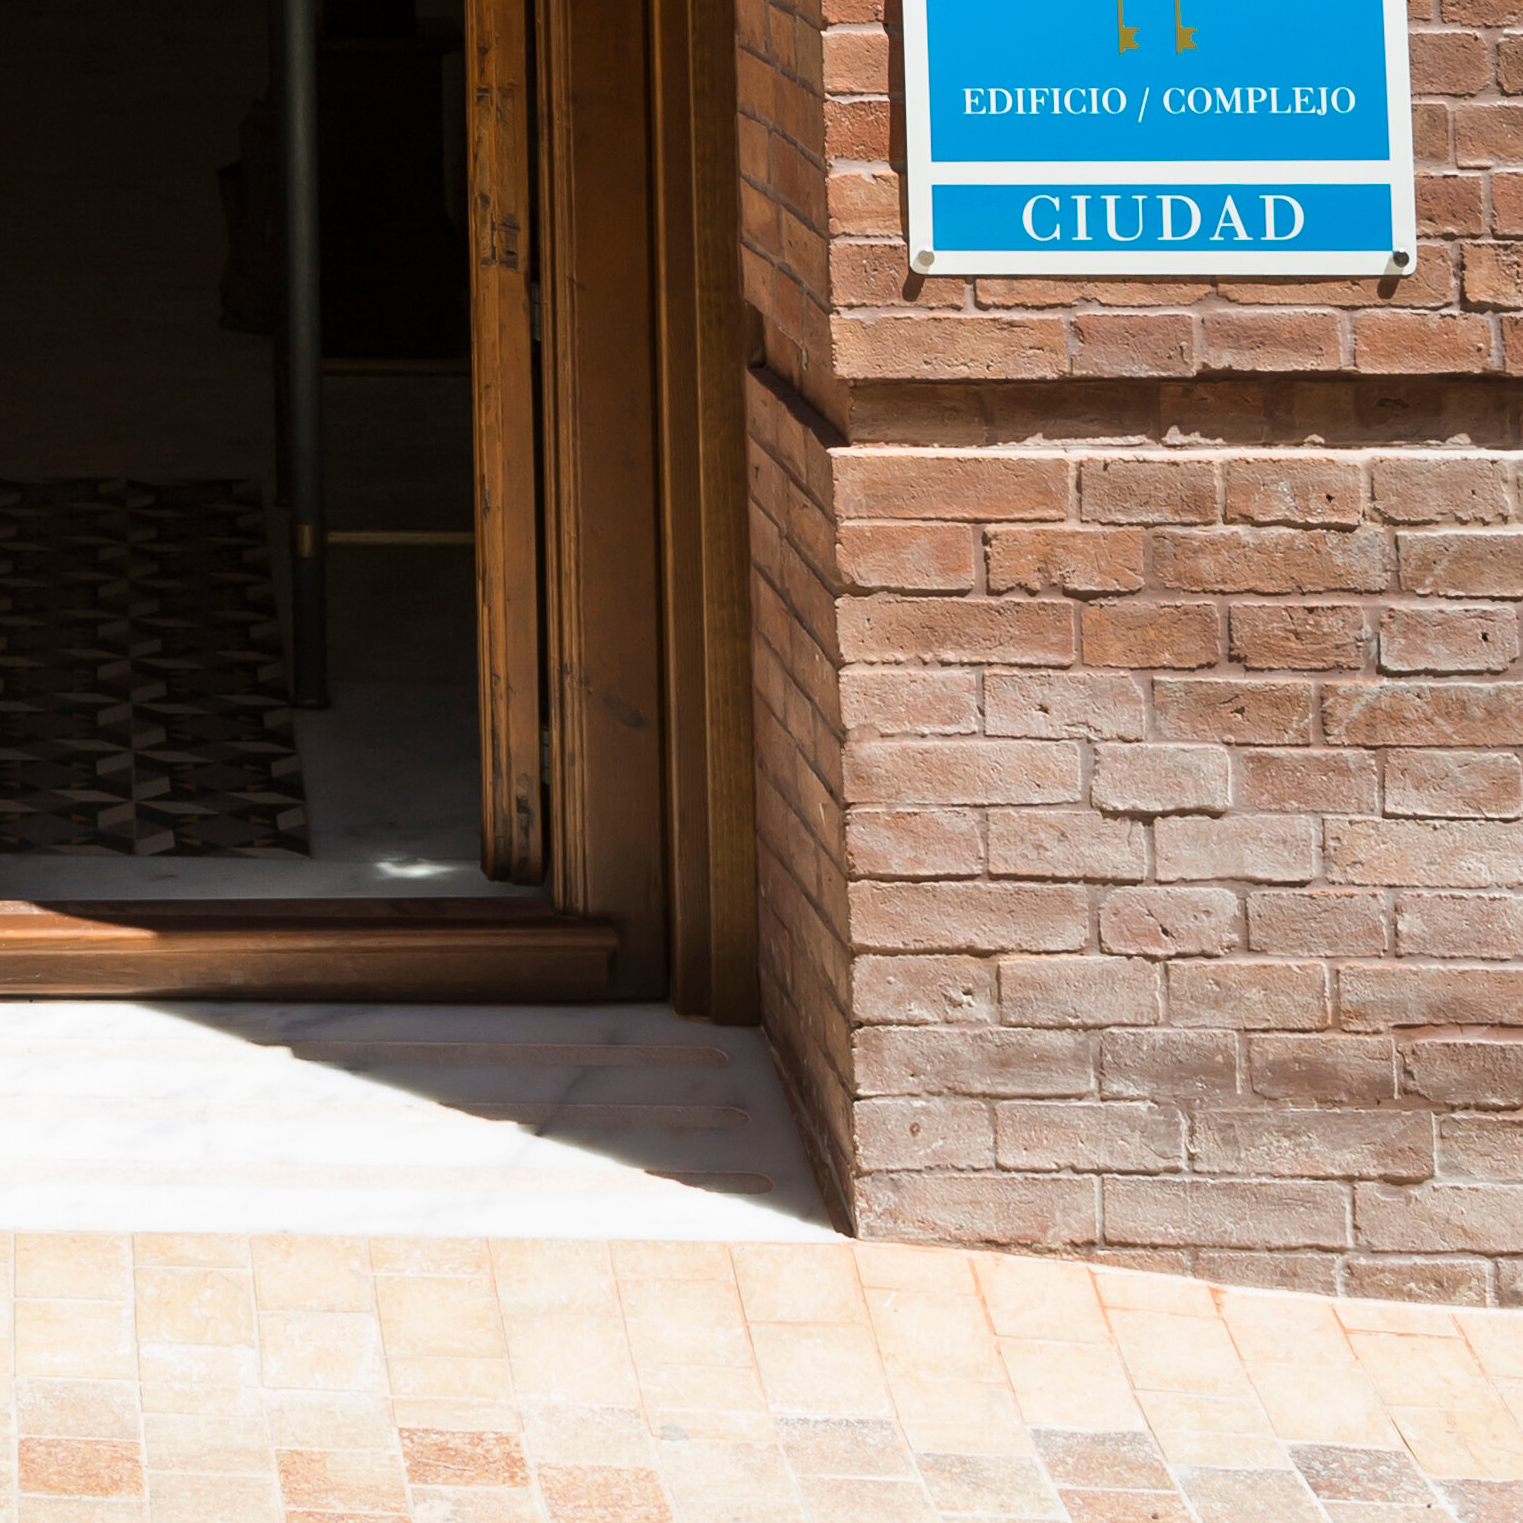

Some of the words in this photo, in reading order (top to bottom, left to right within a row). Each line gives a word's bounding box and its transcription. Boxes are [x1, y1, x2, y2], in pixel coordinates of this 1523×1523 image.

[963, 86, 1128, 116] EDIFICIO
[1162, 85, 1357, 117] COMPLEJO
[1021, 193, 1307, 243] CIUDAD
